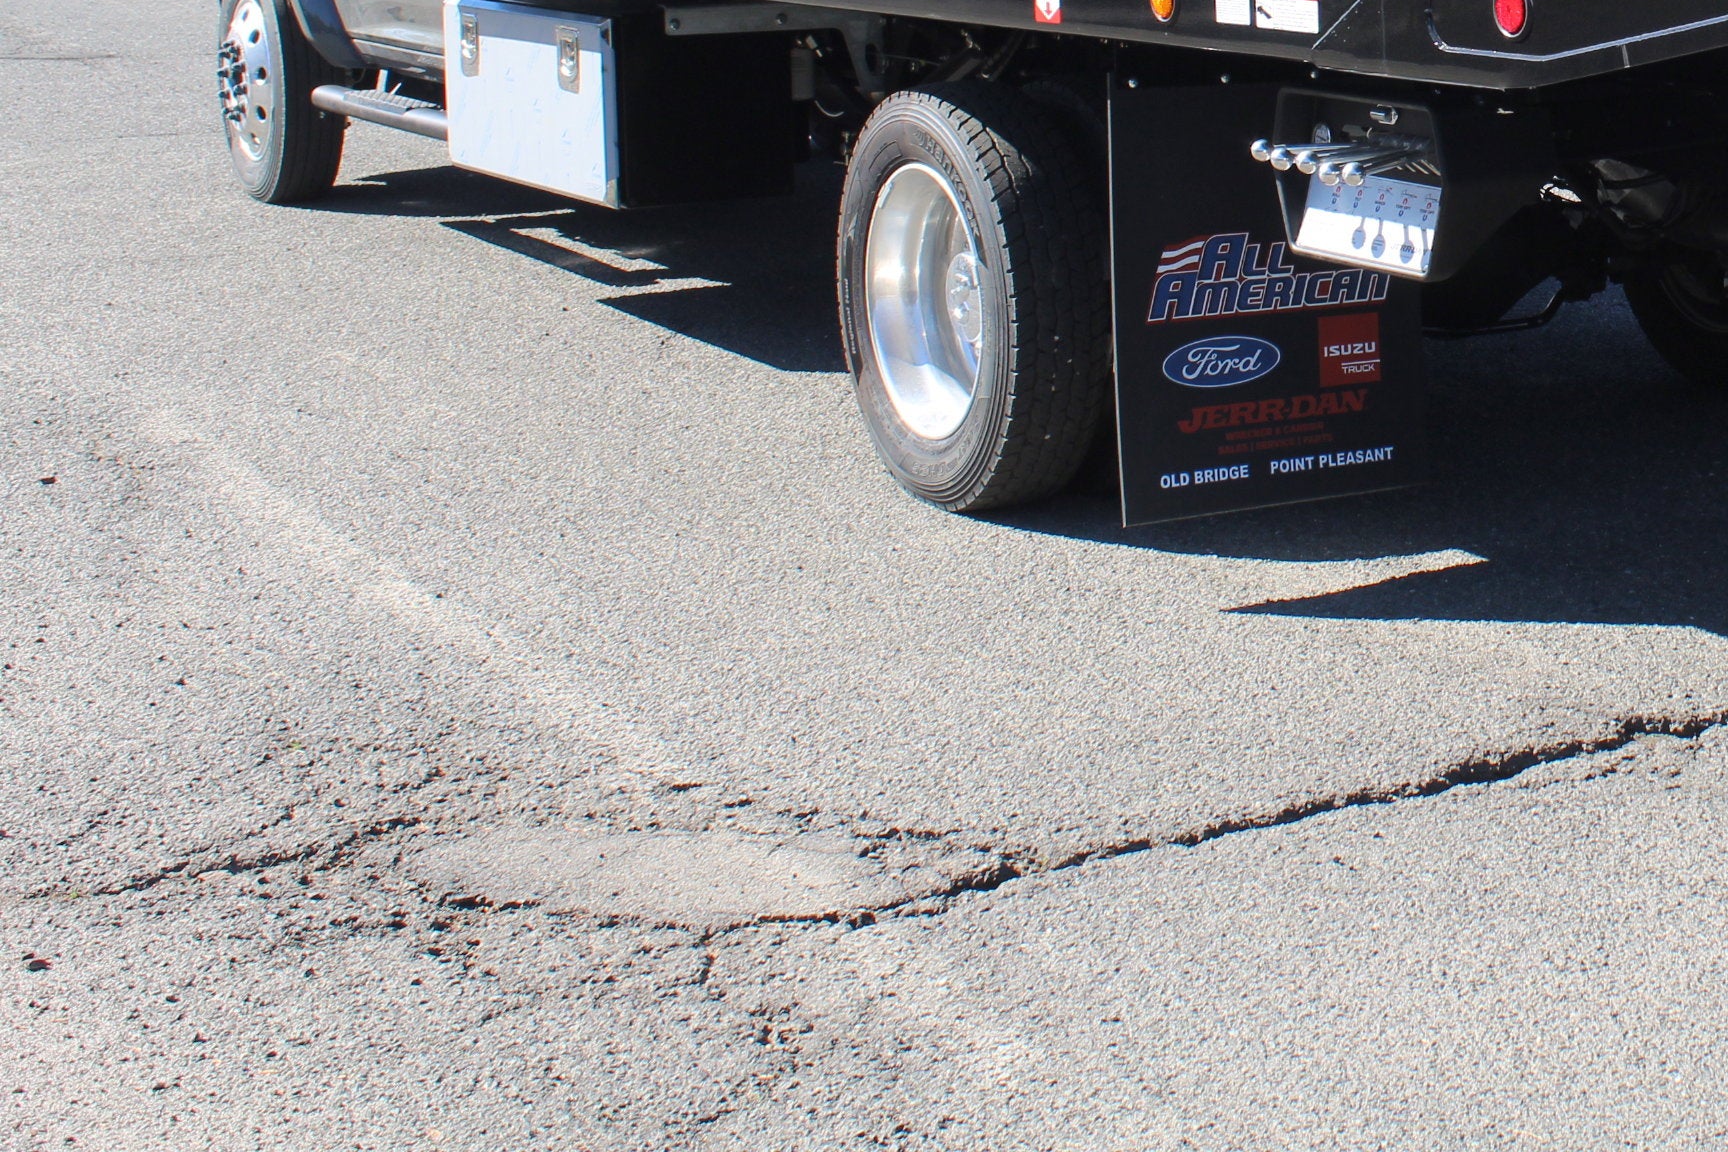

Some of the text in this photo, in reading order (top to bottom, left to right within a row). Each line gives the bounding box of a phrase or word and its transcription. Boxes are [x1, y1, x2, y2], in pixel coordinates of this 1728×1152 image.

[1196, 231, 1296, 281] ALL
[1146, 268, 1391, 323] AMERICAN
[1181, 343, 1262, 381] Ford
[1323, 341, 1376, 358] ISUZU
[1341, 363, 1376, 375] TRUCK
[1270, 446, 1394, 475] POINT PLEASANT
[1160, 464, 1249, 489] OLD BRIDGE
